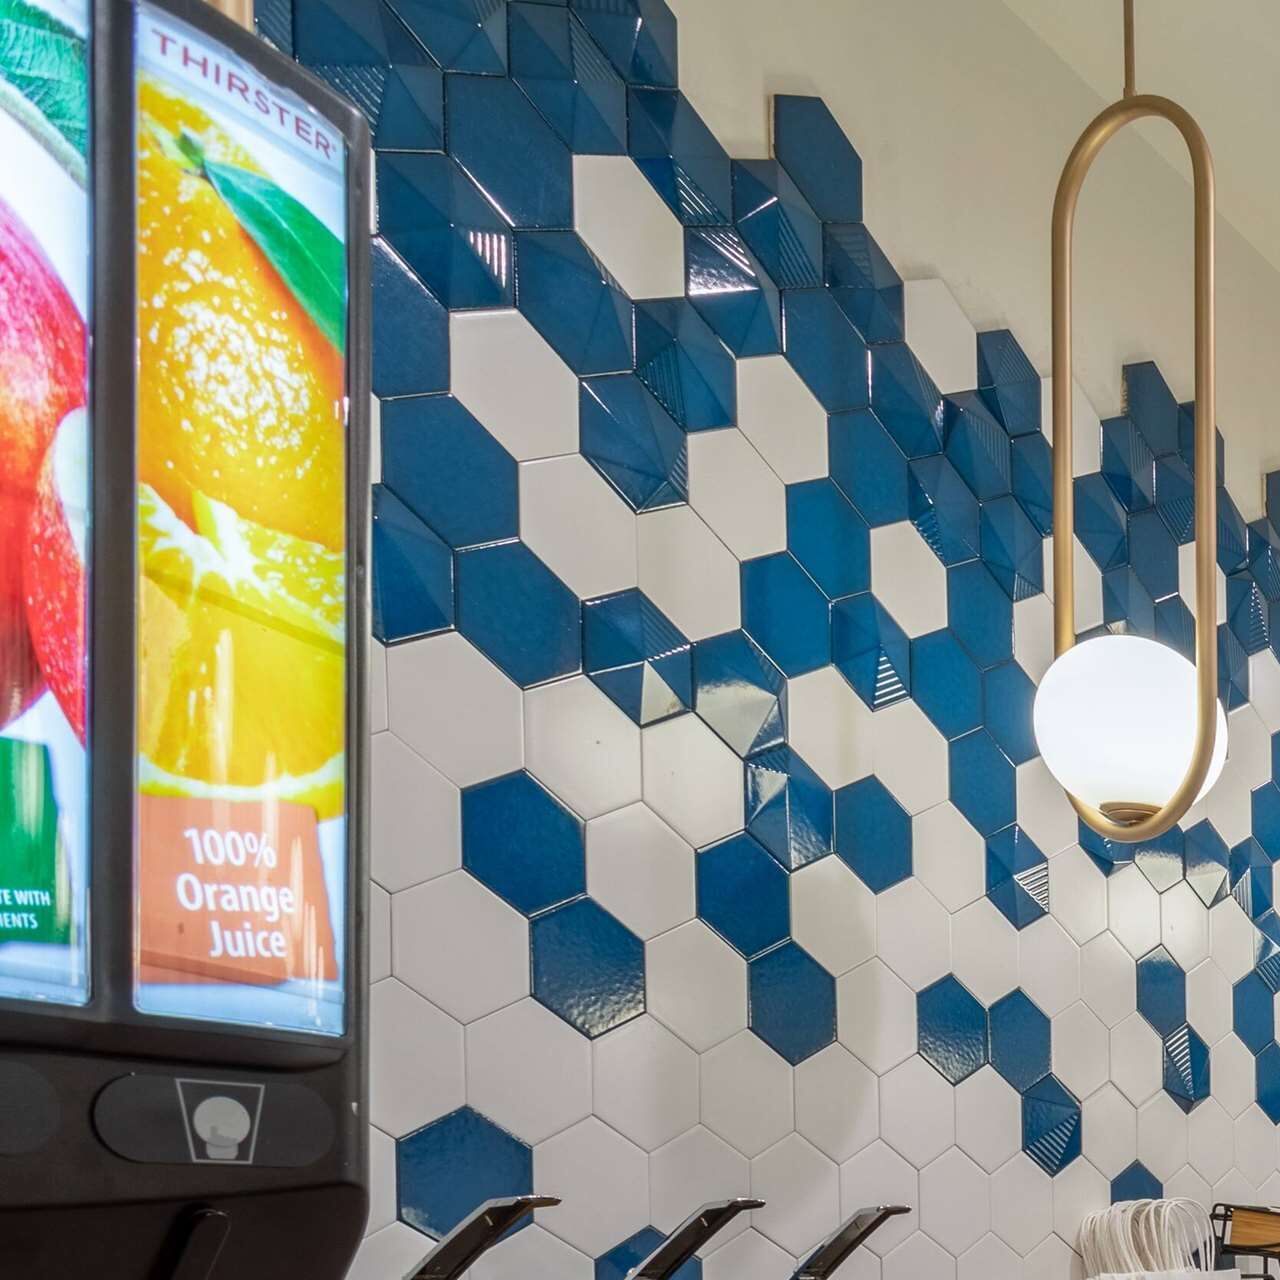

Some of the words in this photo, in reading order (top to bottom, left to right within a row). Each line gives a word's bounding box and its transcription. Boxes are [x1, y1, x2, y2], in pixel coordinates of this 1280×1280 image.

[152, 28, 332, 160] THIRSTER
[183, 827, 277, 869] 100%
[13, 889, 51, 906] WITH
[176, 872, 297, 923] Orange
[209, 920, 287, 958] Juice
